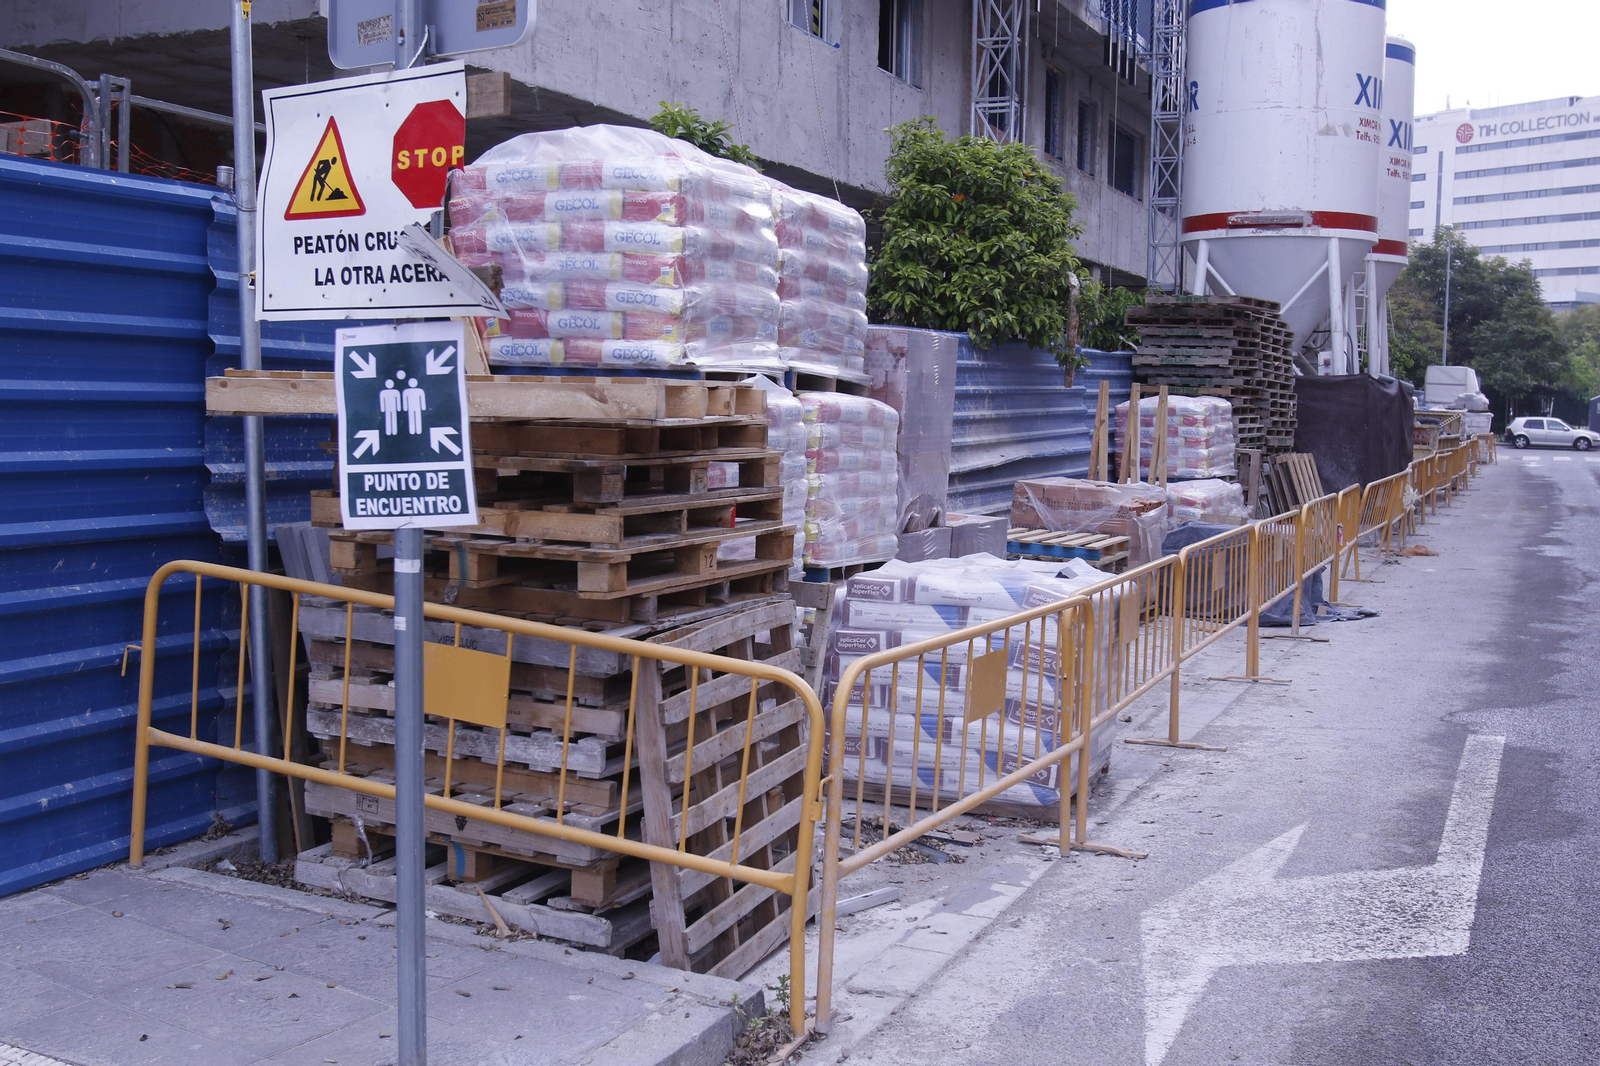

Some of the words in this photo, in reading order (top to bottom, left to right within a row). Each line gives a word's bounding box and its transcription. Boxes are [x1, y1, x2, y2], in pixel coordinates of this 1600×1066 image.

[1500, 111, 1590, 135] COLLECTION
[396, 145, 464, 170] STOP
[555, 197, 599, 211] GECOL
[293, 229, 360, 254] PEATÓN
[614, 232, 660, 245] GECOL
[314, 268, 335, 286] LA
[340, 265, 385, 284] OTRA
[616, 292, 660, 306] GECOL
[557, 318, 601, 330] GECOL
[500, 345, 542, 357] GECOL
[612, 348, 657, 361] GECOL
[364, 473, 421, 491] PUNTO
[426, 472, 450, 490] DE
[356, 496, 462, 515] ENCUENTRO
[704, 554, 714, 568] 12
